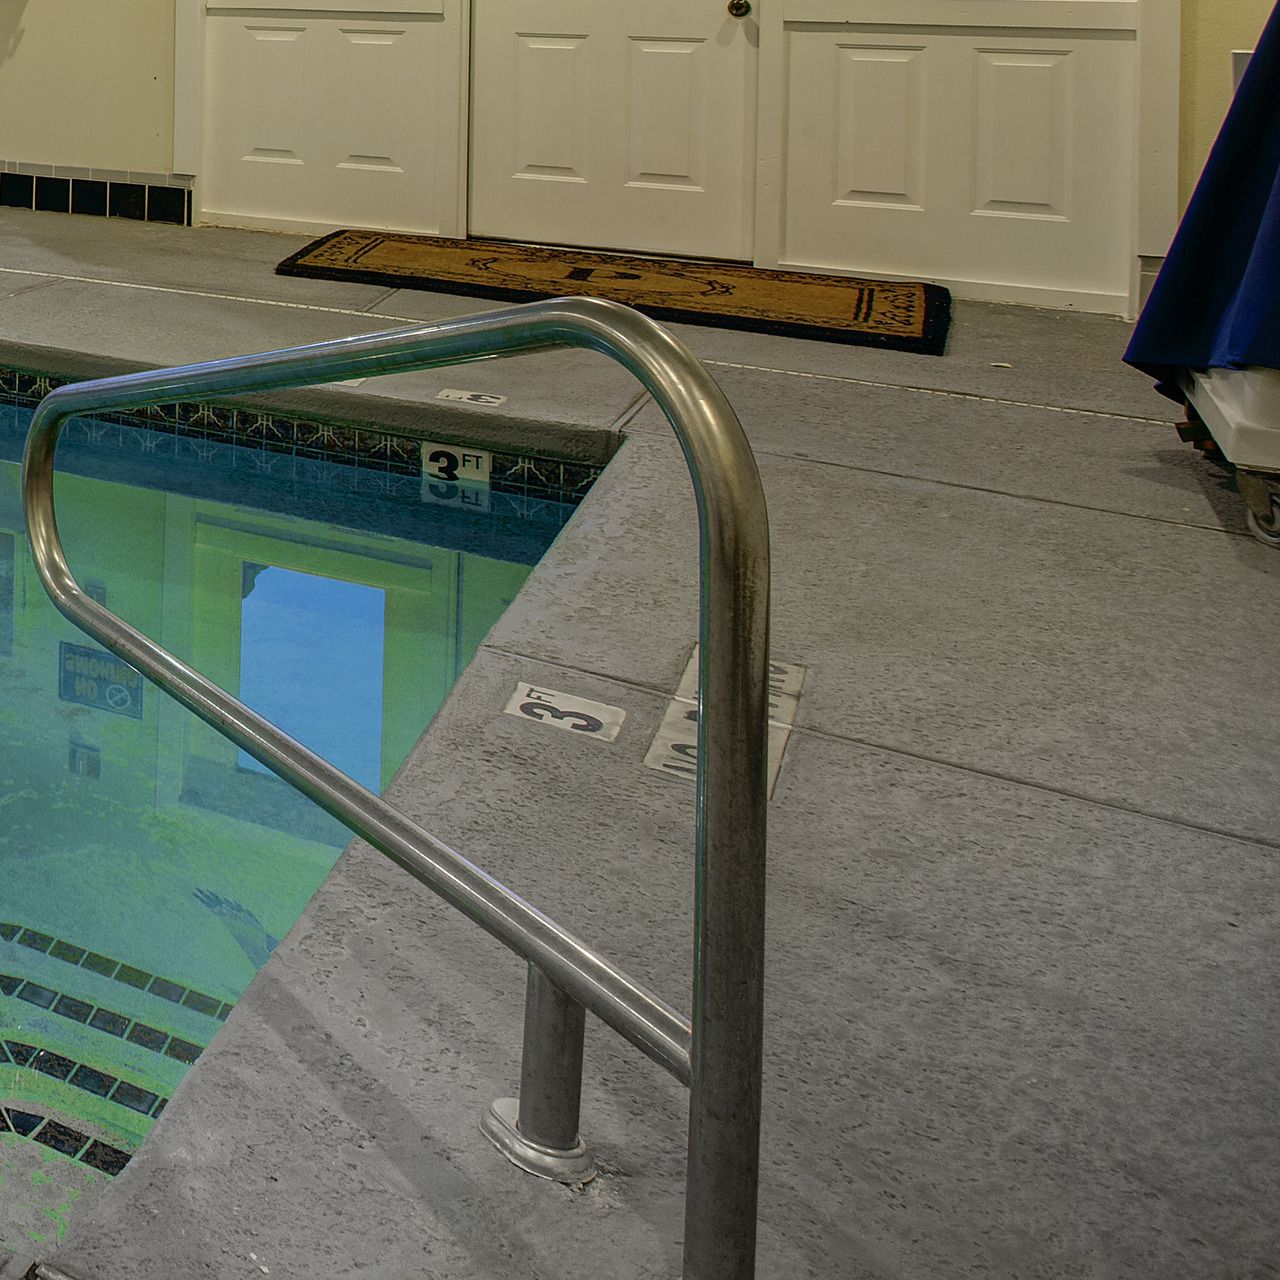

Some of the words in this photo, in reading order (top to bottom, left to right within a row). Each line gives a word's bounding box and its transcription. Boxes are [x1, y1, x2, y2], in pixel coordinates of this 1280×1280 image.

[428, 449, 460, 482] 3
[462, 453, 484, 470] FT
[525, 687, 556, 704] FT
[519, 701, 604, 733] 3
